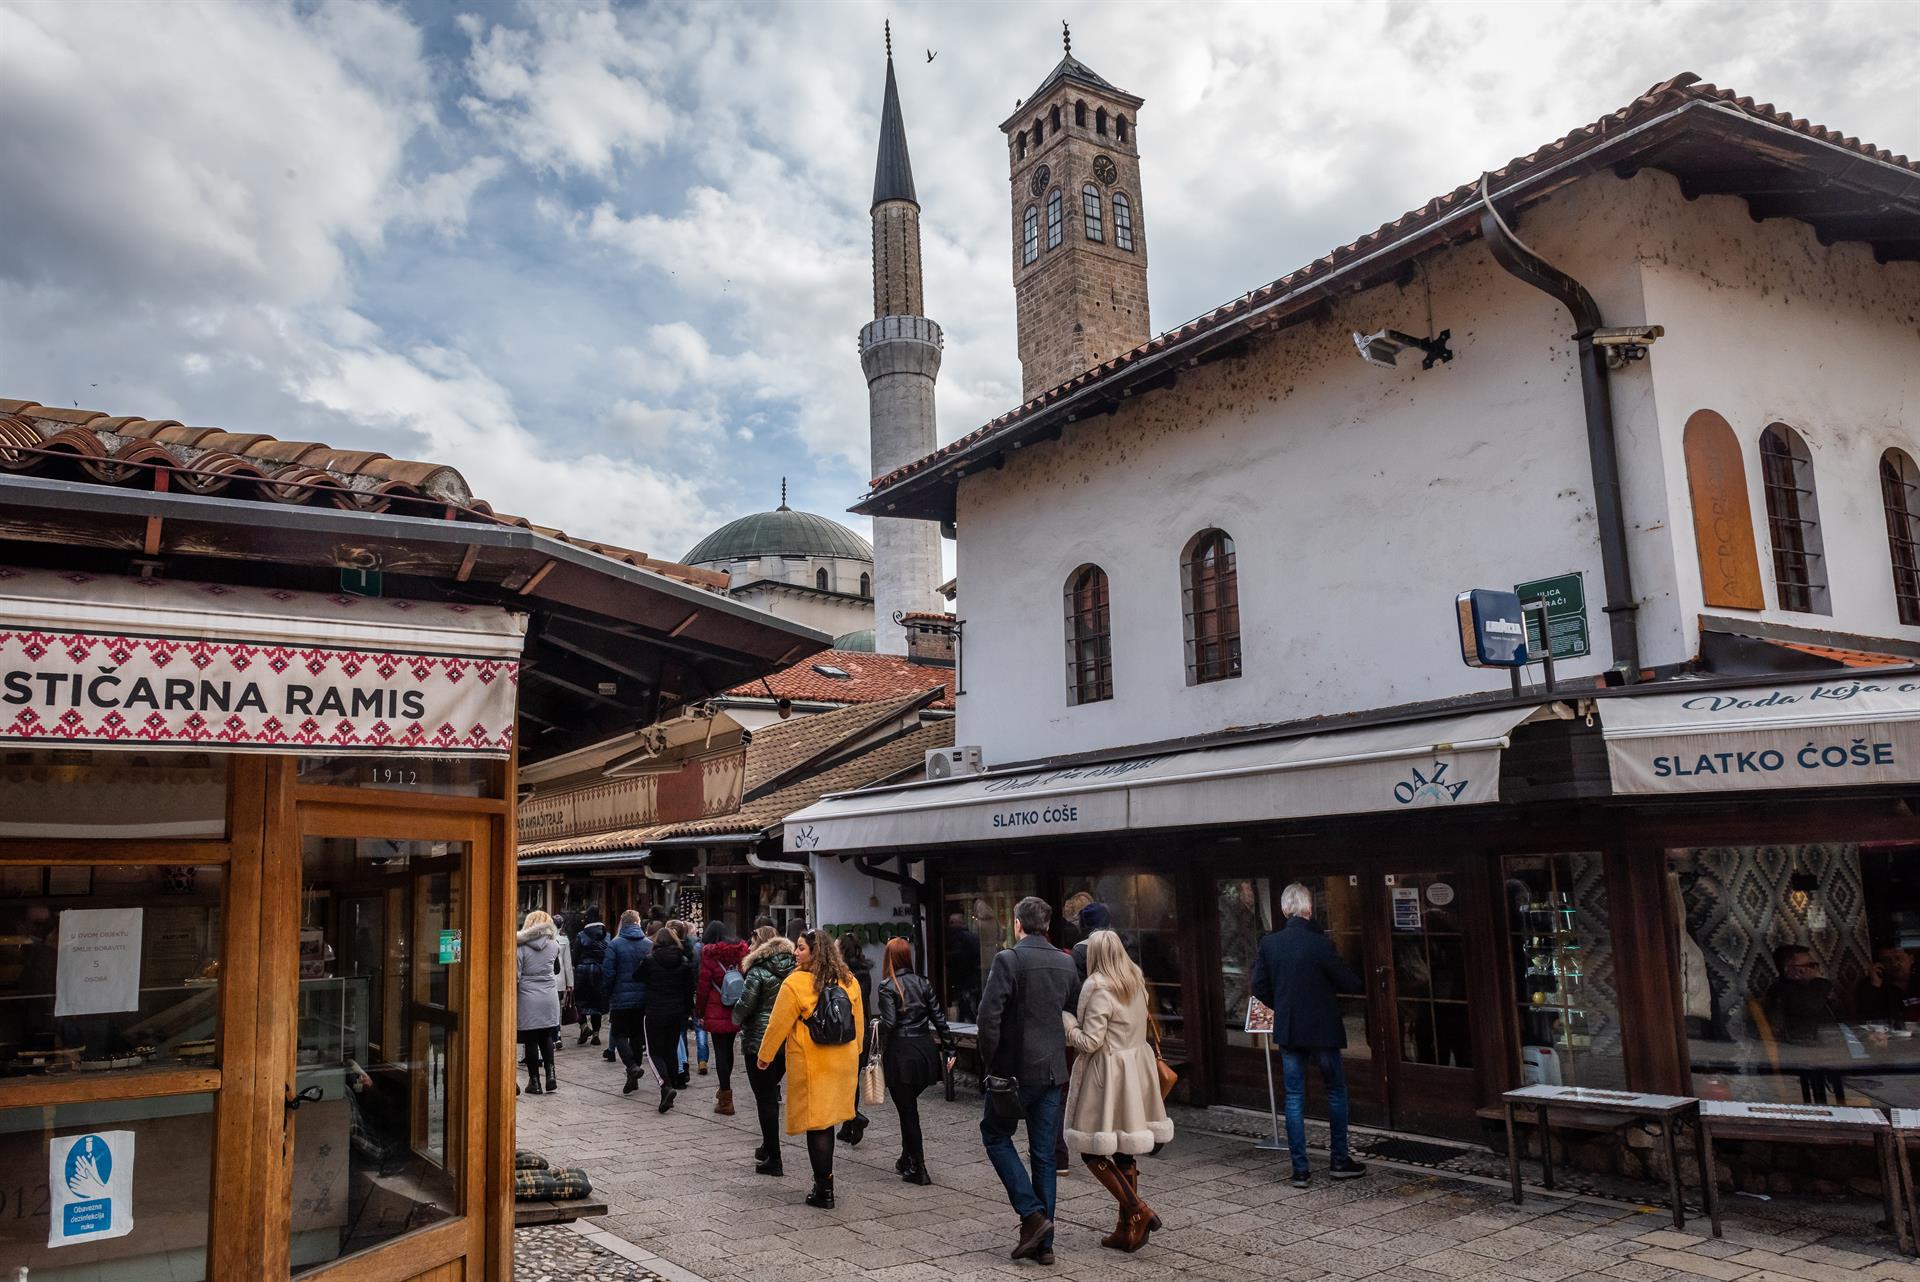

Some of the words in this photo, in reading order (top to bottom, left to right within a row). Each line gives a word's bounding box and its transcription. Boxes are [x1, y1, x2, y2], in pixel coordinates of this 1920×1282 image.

[2, 665, 268, 714] STIČARNA
[285, 684, 425, 720] RAMIS
[1681, 691, 1804, 712] Voda
[1810, 681, 1891, 701] koja
[1653, 749, 1785, 777] SLATKO
[1797, 738, 1895, 769] ĆOŠE
[372, 768, 417, 786] 1912
[1393, 760, 1469, 804] OAZA
[993, 810, 1039, 828] SLATKO
[1043, 804, 1078, 826] ĆOŠE
[92, 960, 100, 968] 5
[73, 1204, 102, 1213] Obavezna
